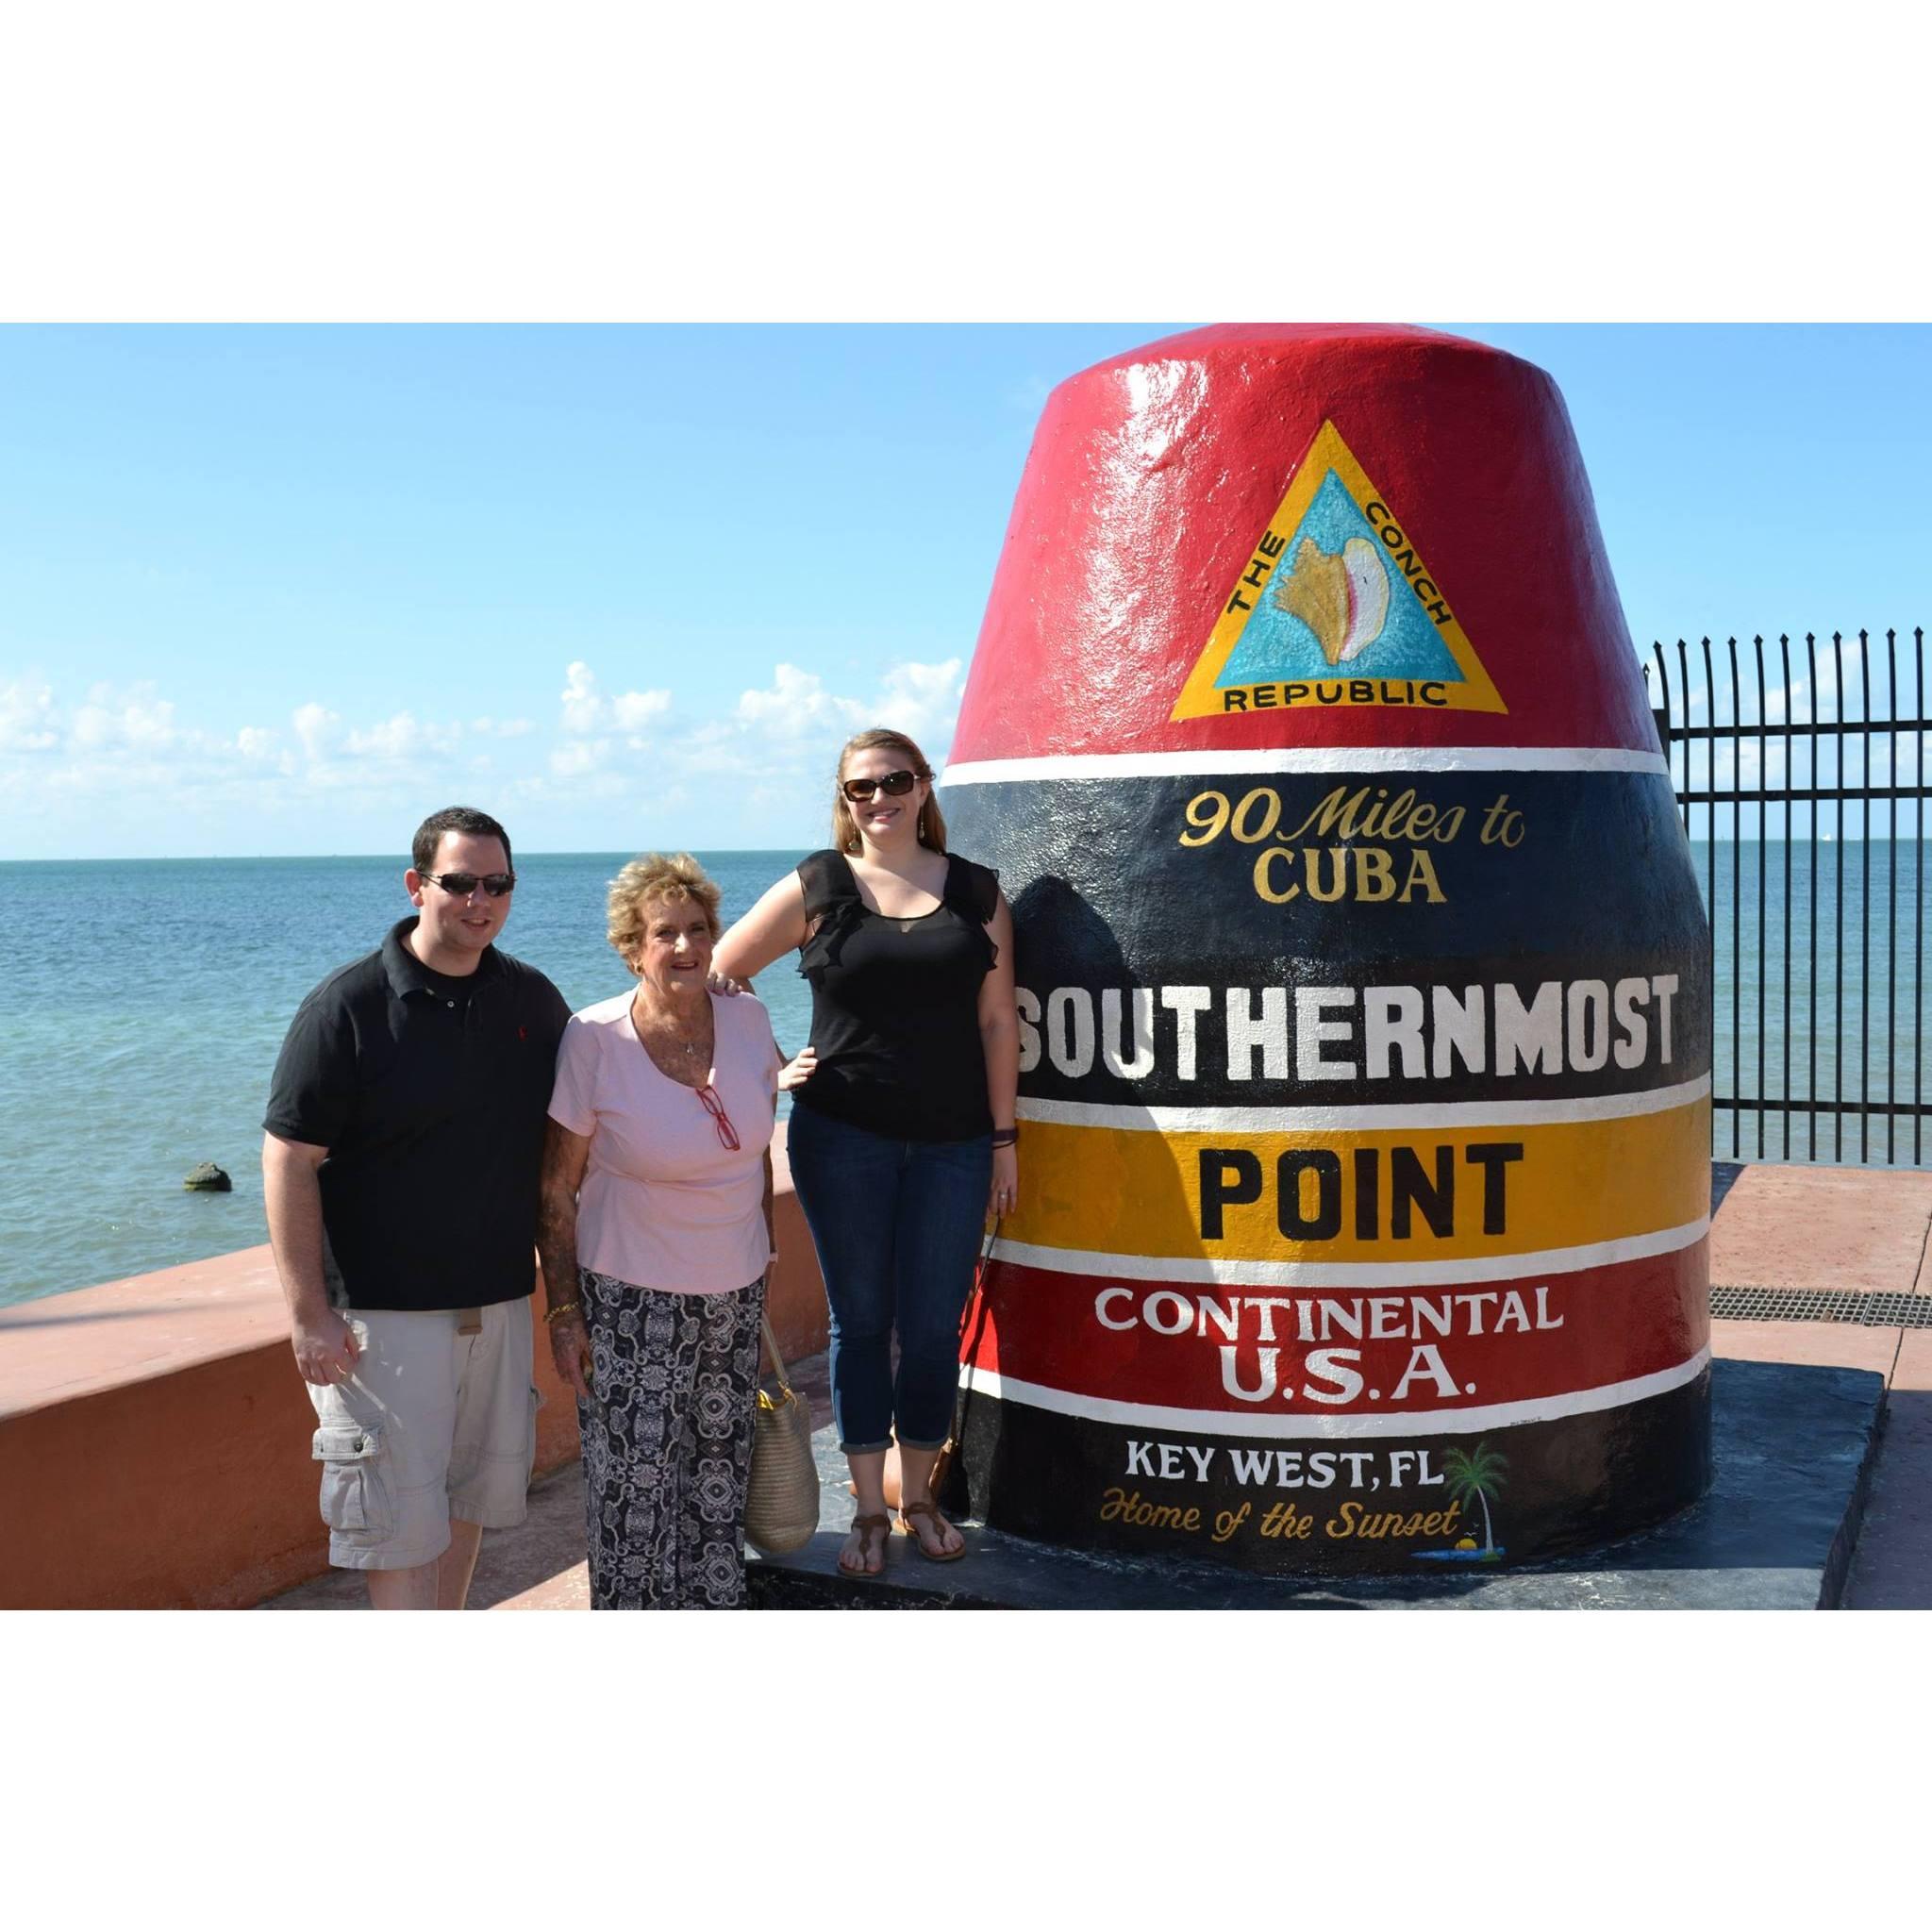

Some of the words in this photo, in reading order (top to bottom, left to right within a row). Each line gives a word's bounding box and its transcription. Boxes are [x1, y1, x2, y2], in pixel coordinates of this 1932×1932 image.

[1227, 530, 1286, 614] THE
[1366, 501, 1452, 625] CONCH
[1224, 681, 1448, 712] REPUBLIC
[1178, 787, 1281, 847] 90
[1275, 786, 1467, 842] Miles
[1480, 794, 1525, 848] to
[1253, 847, 1447, 904] CUBA
[1014, 974, 1678, 1080] SOUTHERNMOST
[1199, 1142, 1524, 1242] POINT
[1094, 1287, 1564, 1341] CONTINENTAL
[1219, 1344, 1477, 1405] U.S.A.
[1124, 1441, 1216, 1482] KEY
[1228, 1450, 1380, 1492] WEST,
[1389, 1451, 1444, 1487] FL
[1100, 1488, 1201, 1531] Home
[1211, 1502, 1245, 1542] of
[1261, 1504, 1314, 1540] the
[1325, 1500, 1461, 1541] Sunset
